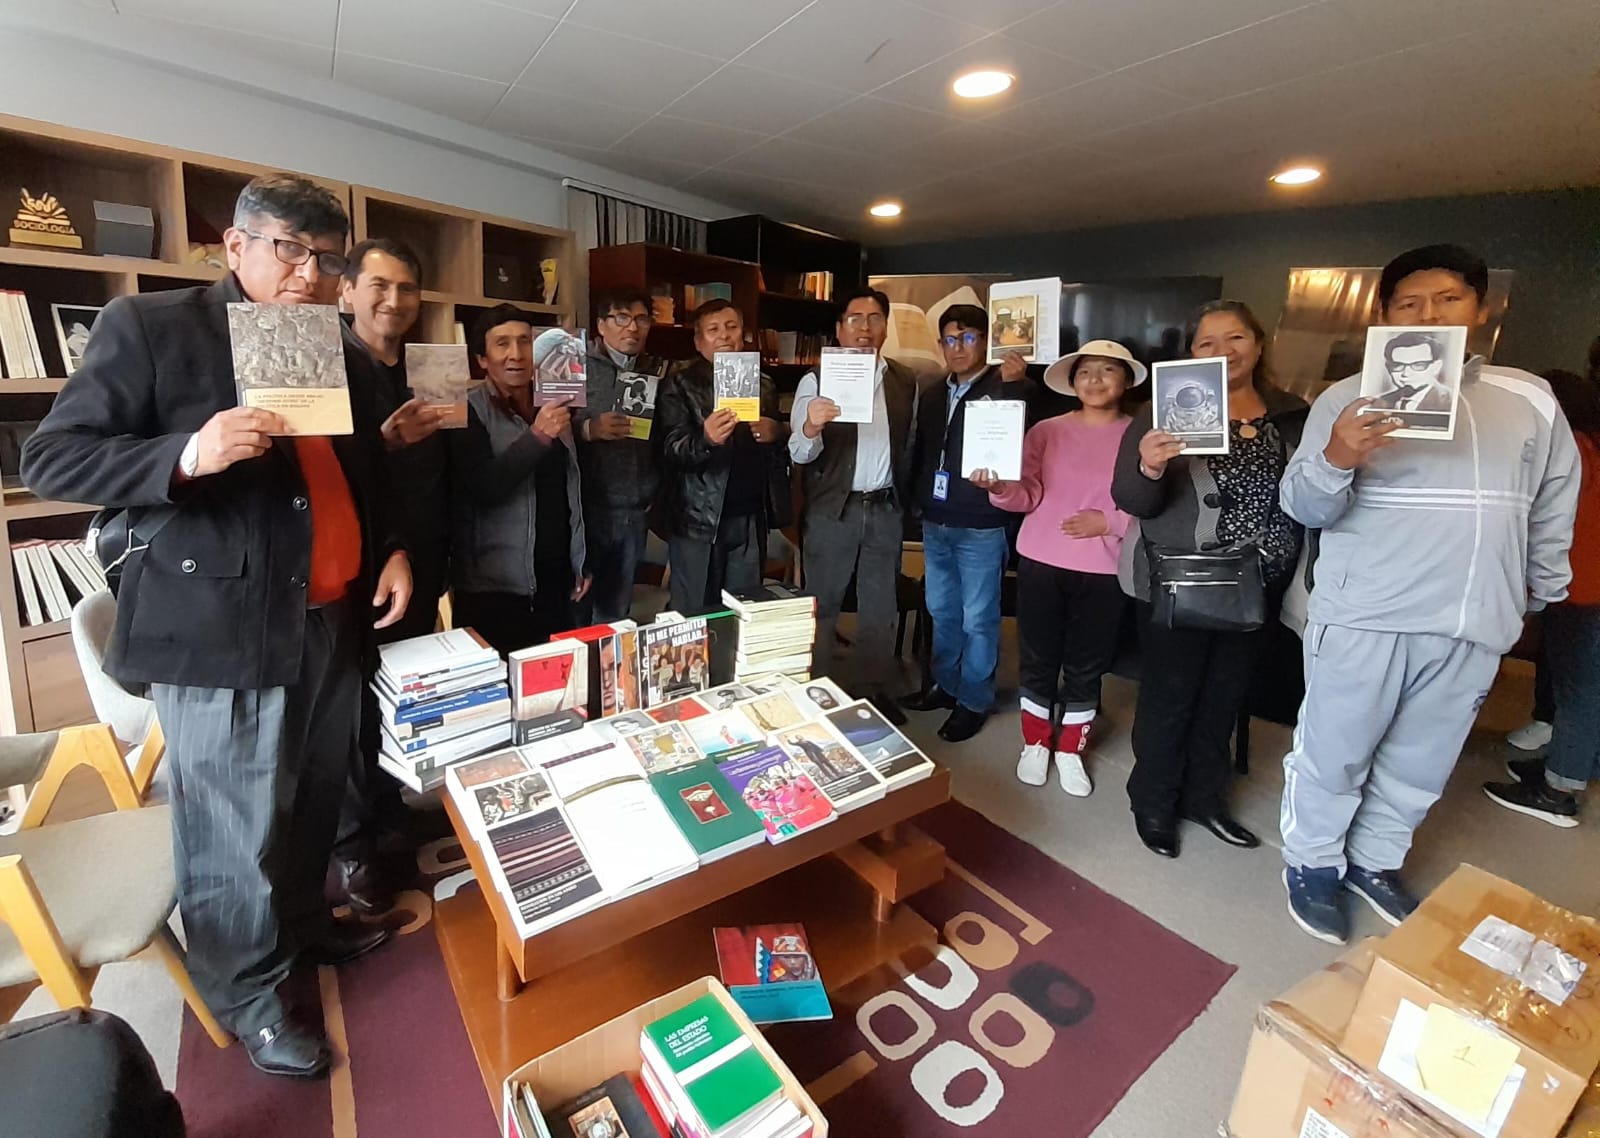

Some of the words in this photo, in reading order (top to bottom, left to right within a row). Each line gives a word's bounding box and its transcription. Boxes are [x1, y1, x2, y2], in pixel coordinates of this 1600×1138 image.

[656, 628, 668, 641] ME
[668, 618, 707, 637] PERMITEN
[664, 1031, 678, 1043] LAS
[677, 1015, 709, 1036] EMPRESAS
[668, 1038, 683, 1049] DEL
[681, 1025, 708, 1042] ESTADO
